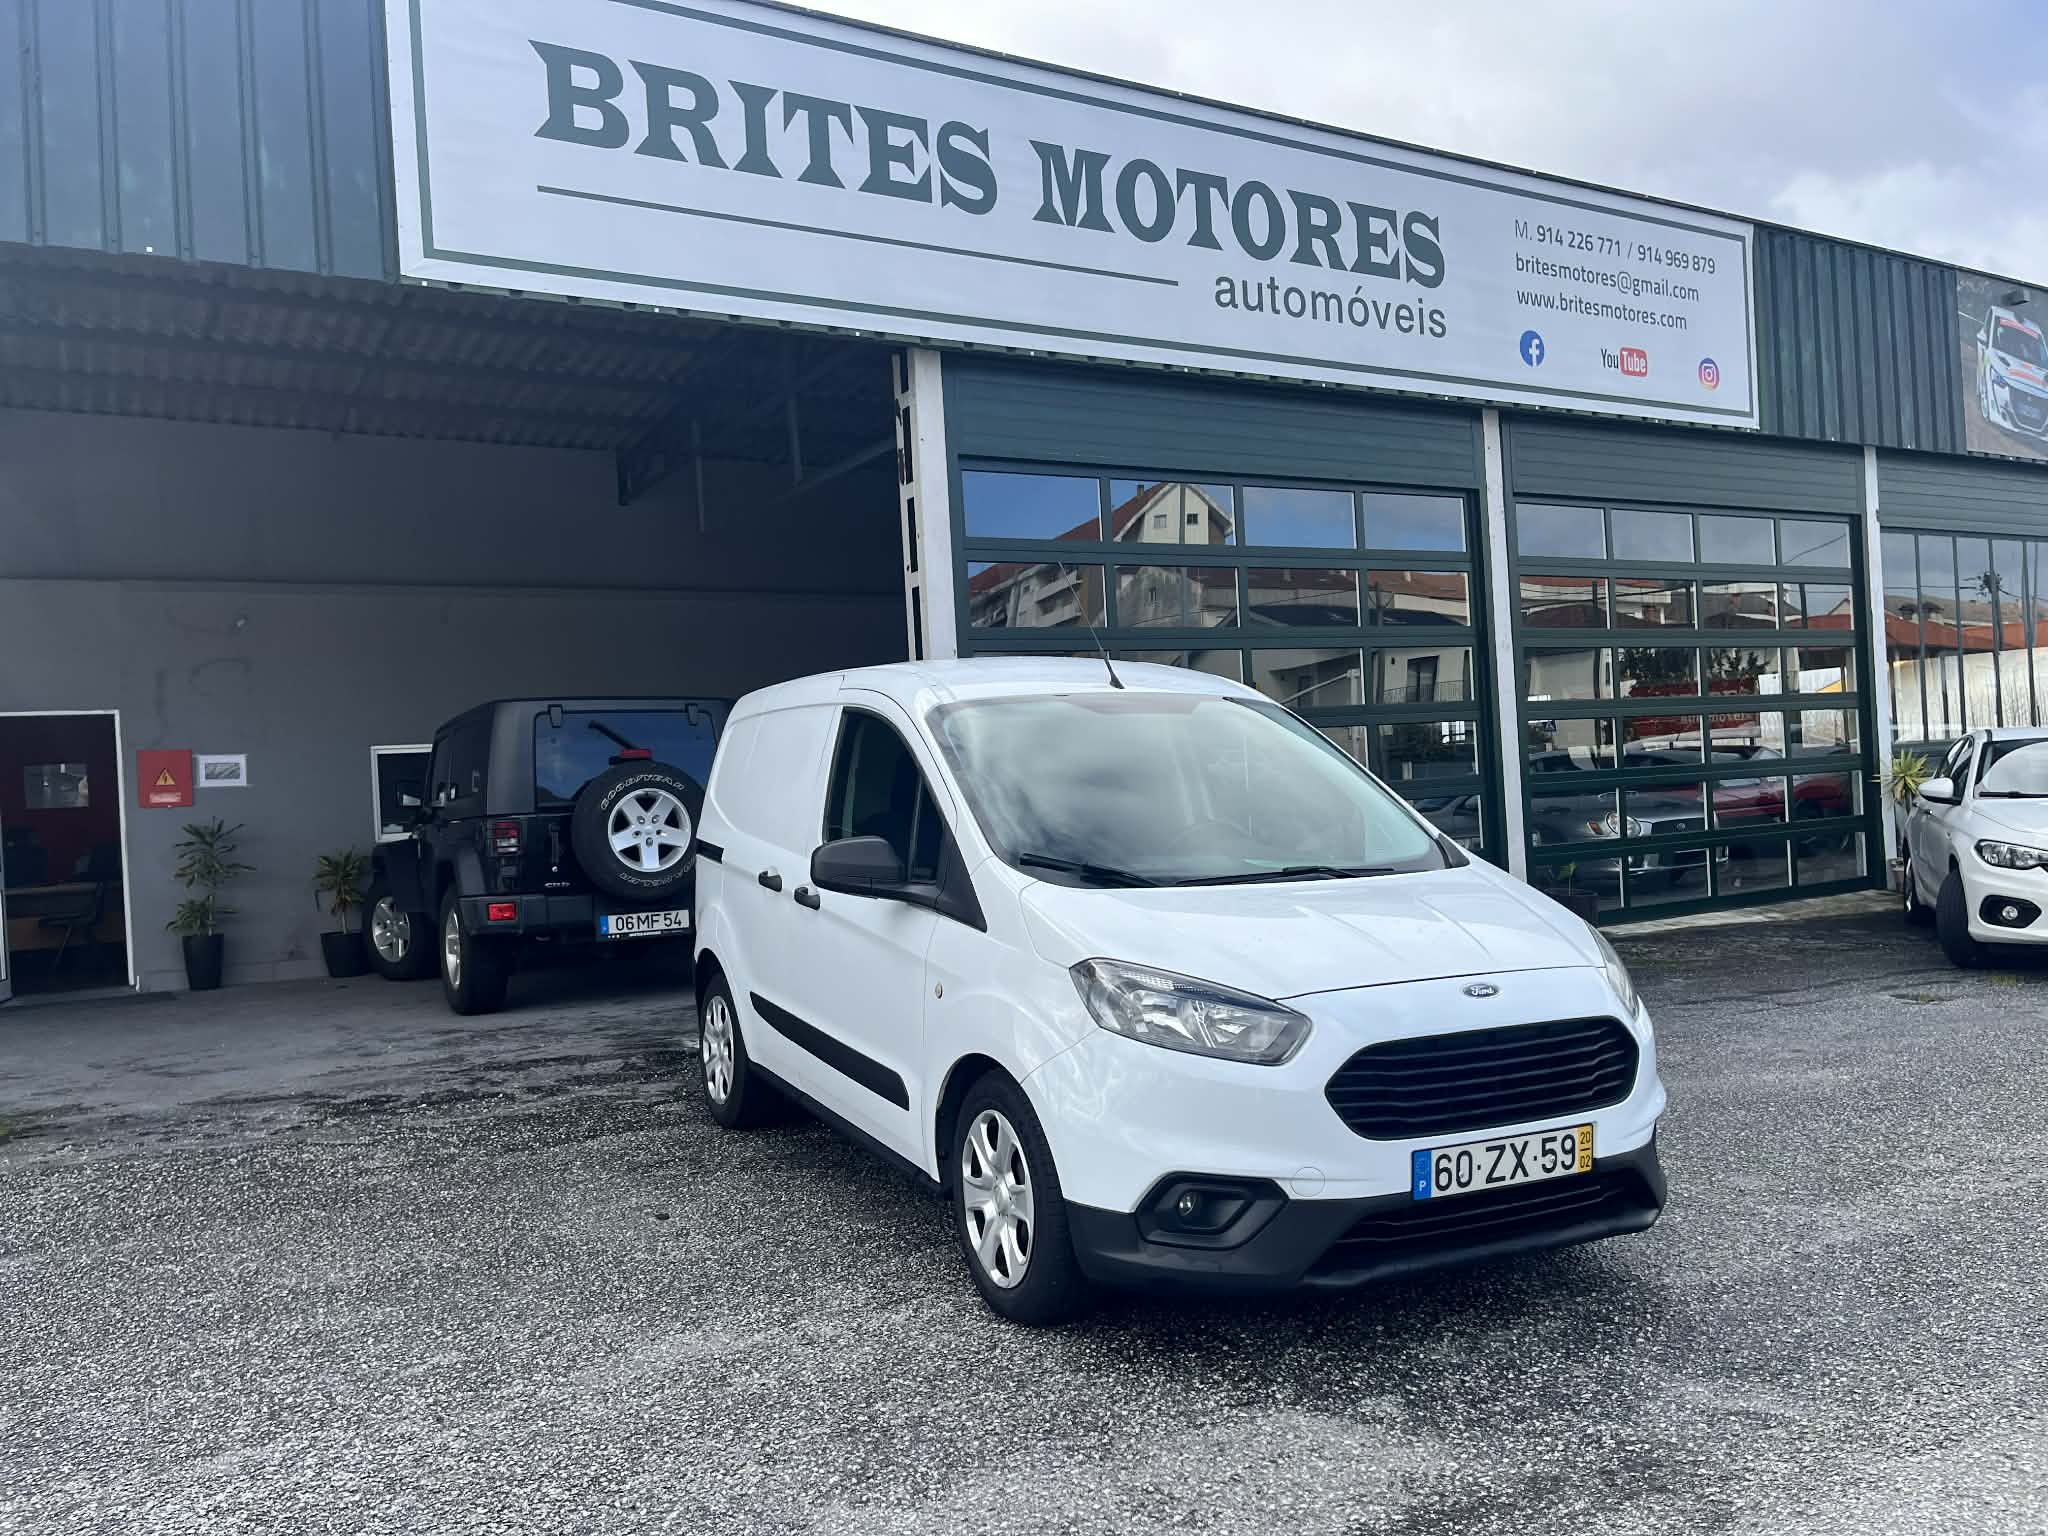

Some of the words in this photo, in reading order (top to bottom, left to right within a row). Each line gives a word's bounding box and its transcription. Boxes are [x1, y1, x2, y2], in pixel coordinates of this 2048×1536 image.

[528, 39, 998, 215] BRITES
[1028, 139, 1445, 289] MOTORES
[1514, 219, 1532, 241] M.
[1536, 225, 1564, 246] 914
[1567, 231, 1594, 251] 226
[1598, 236, 1621, 257] 771
[1637, 245, 1662, 265] 914
[1665, 251, 1689, 269] 969
[1692, 257, 1716, 274] 879
[1515, 253, 1700, 301] britesmotores@gmail.com
[1215, 275, 1447, 338] automóveis
[1516, 290, 1688, 330] www.britesmotores.com
[1580, 1131, 1591, 1145] 20
[1580, 1154, 1591, 1168] 02
[1419, 1180, 1426, 1191] P
